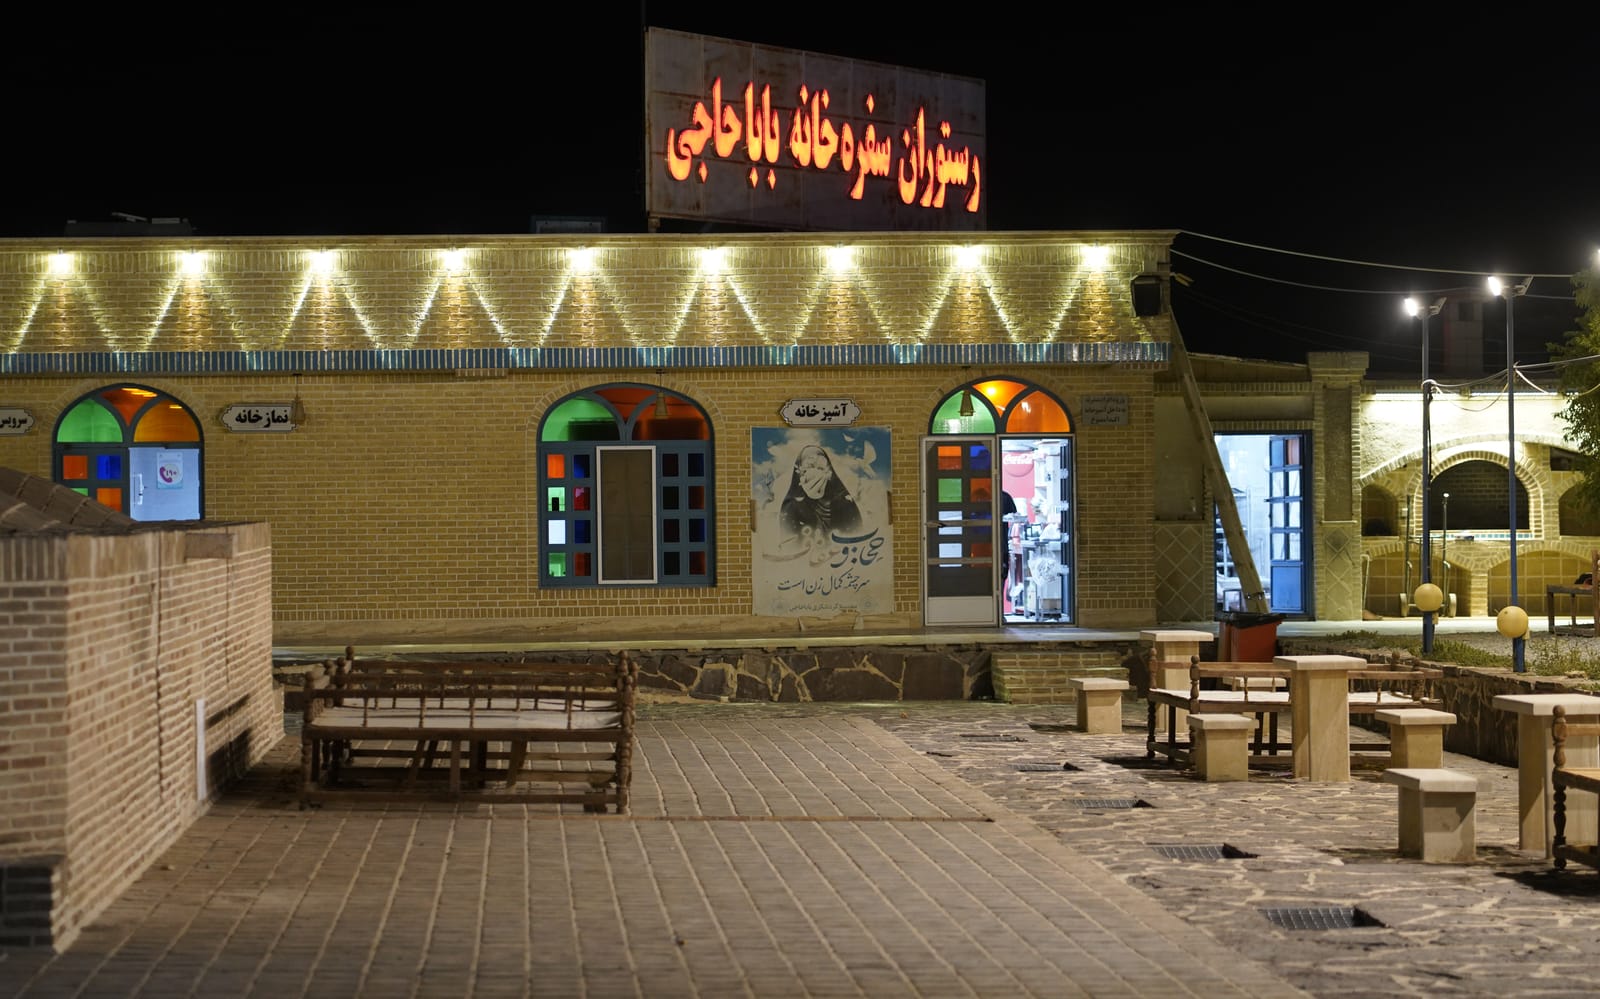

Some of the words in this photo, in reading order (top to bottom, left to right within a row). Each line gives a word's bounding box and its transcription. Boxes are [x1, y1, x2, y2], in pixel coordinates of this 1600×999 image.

[667, 76, 743, 184] حاجی
[745, 80, 780, 189] بابا
[790, 84, 839, 169] خانه
[841, 93, 892, 200] سفره
[898, 106, 981, 212] رستوران
[235, 409, 288, 428] نمازخانه
[795, 403, 848, 421] آشپزخانه
[831, 527, 885, 565] حجاب
[777, 578, 805, 591] است
[806, 577, 823, 595] زن
